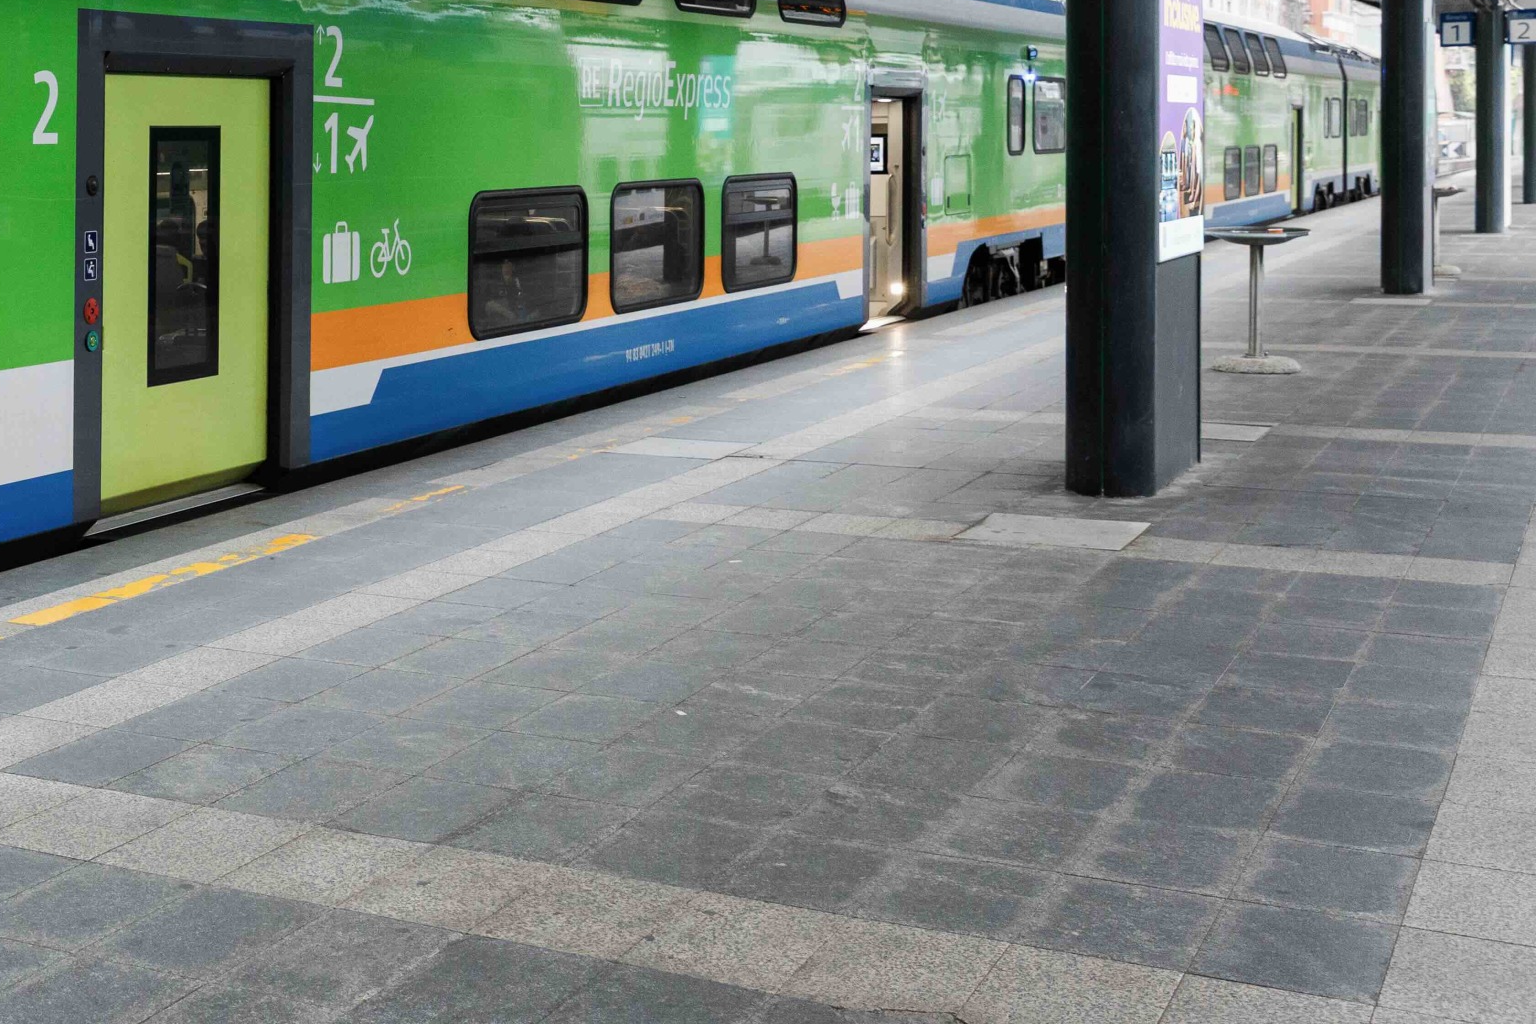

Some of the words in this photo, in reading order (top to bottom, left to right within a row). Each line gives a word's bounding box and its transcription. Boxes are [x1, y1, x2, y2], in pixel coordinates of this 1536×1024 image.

[324, 25, 344, 88] 2
[1450, 24, 1460, 42] 1
[1517, 22, 1532, 40] 2
[32, 69, 60, 145] 2
[607, 58, 732, 121] RegioExpress
[324, 112, 339, 174] 1
